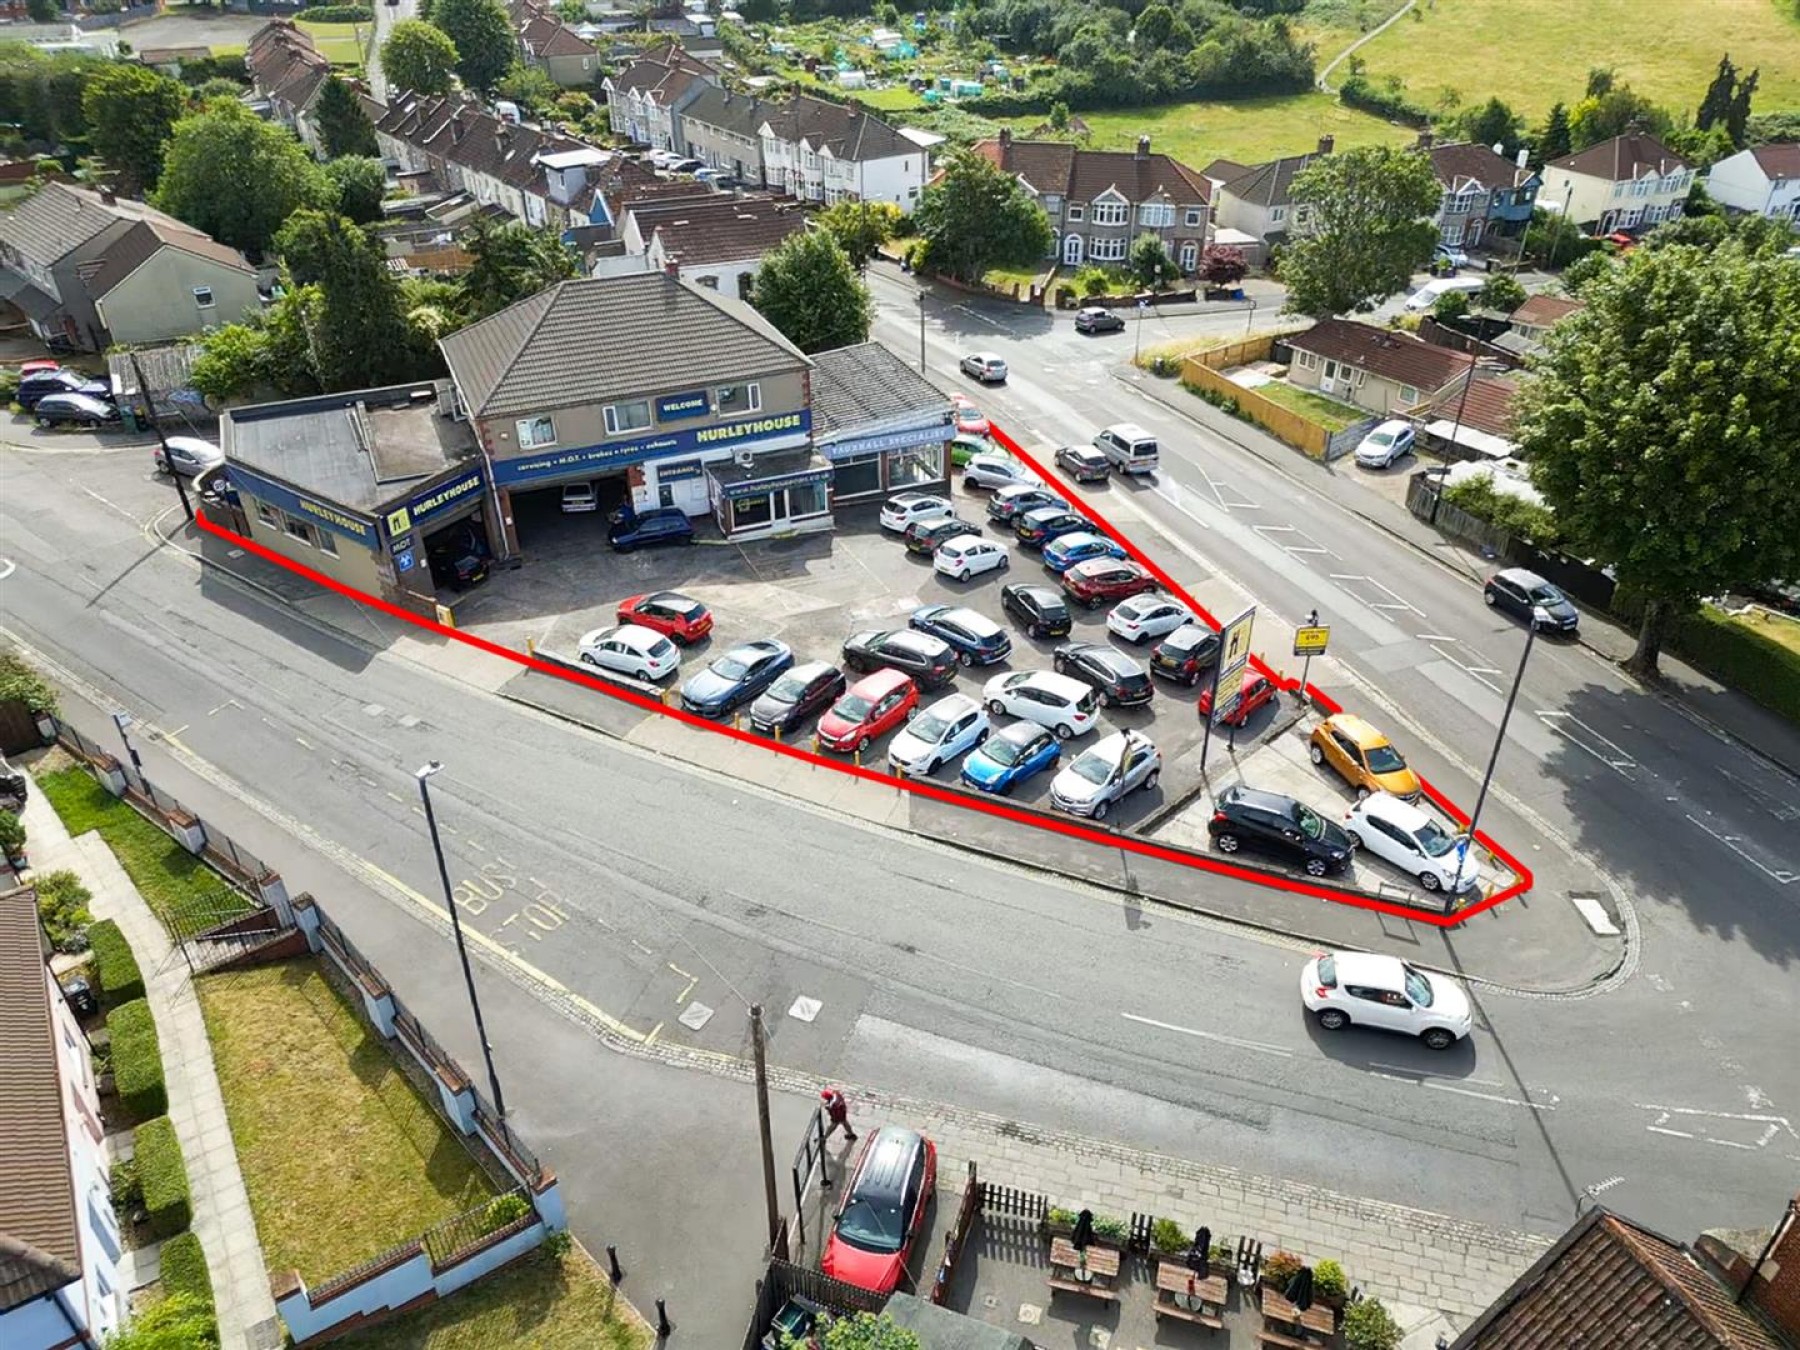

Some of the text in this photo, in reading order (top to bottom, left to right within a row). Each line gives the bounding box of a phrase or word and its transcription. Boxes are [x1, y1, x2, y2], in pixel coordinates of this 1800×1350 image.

[663, 399, 703, 411] WELCOME
[696, 415, 801, 442] HURLEYHOUSE
[888, 429, 945, 445] SPECIALIST
[413, 476, 480, 516] HURLEYHOUSE
[300, 499, 366, 535] HURLEYHOUSE
[393, 538, 411, 553] MOT
[453, 864, 517, 915] BUS
